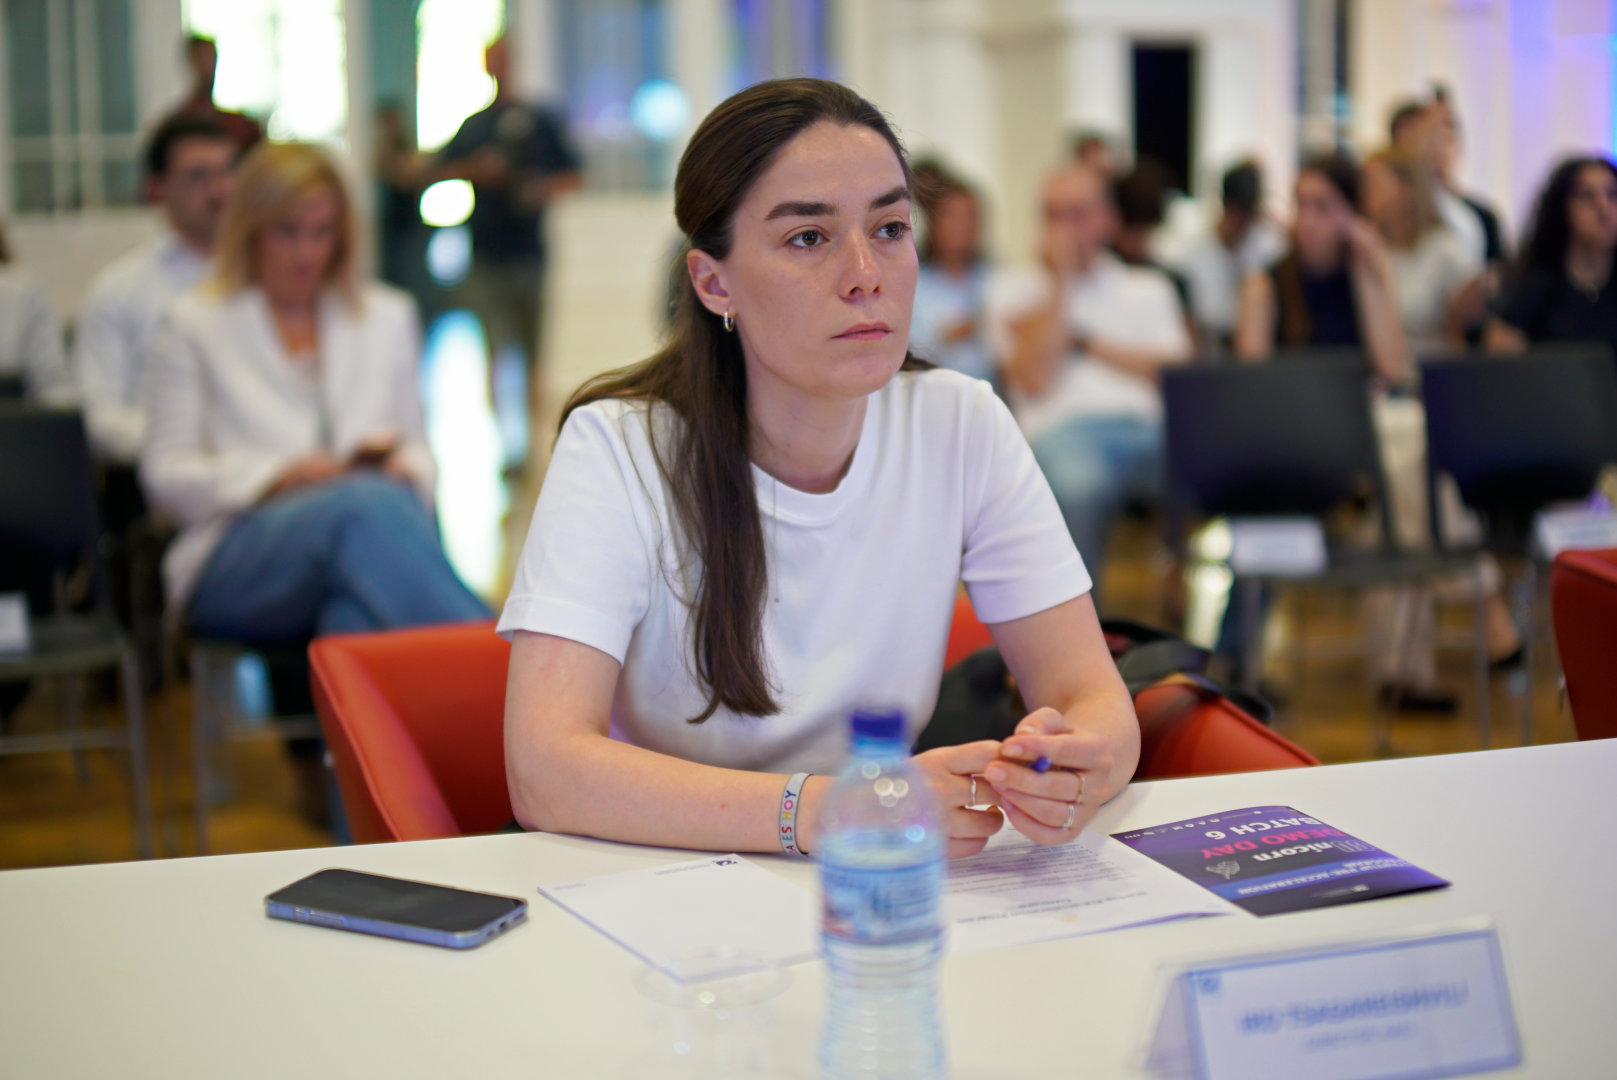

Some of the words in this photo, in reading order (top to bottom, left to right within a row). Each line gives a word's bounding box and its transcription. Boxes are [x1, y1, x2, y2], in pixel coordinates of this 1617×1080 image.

[782, 789, 797, 820] HOY
[781, 826, 793, 841] ES
[1229, 817, 1322, 835] BATCH
[1204, 830, 1226, 840] 6
[1260, 828, 1347, 845] DEMO
[1201, 840, 1260, 859] DAY
